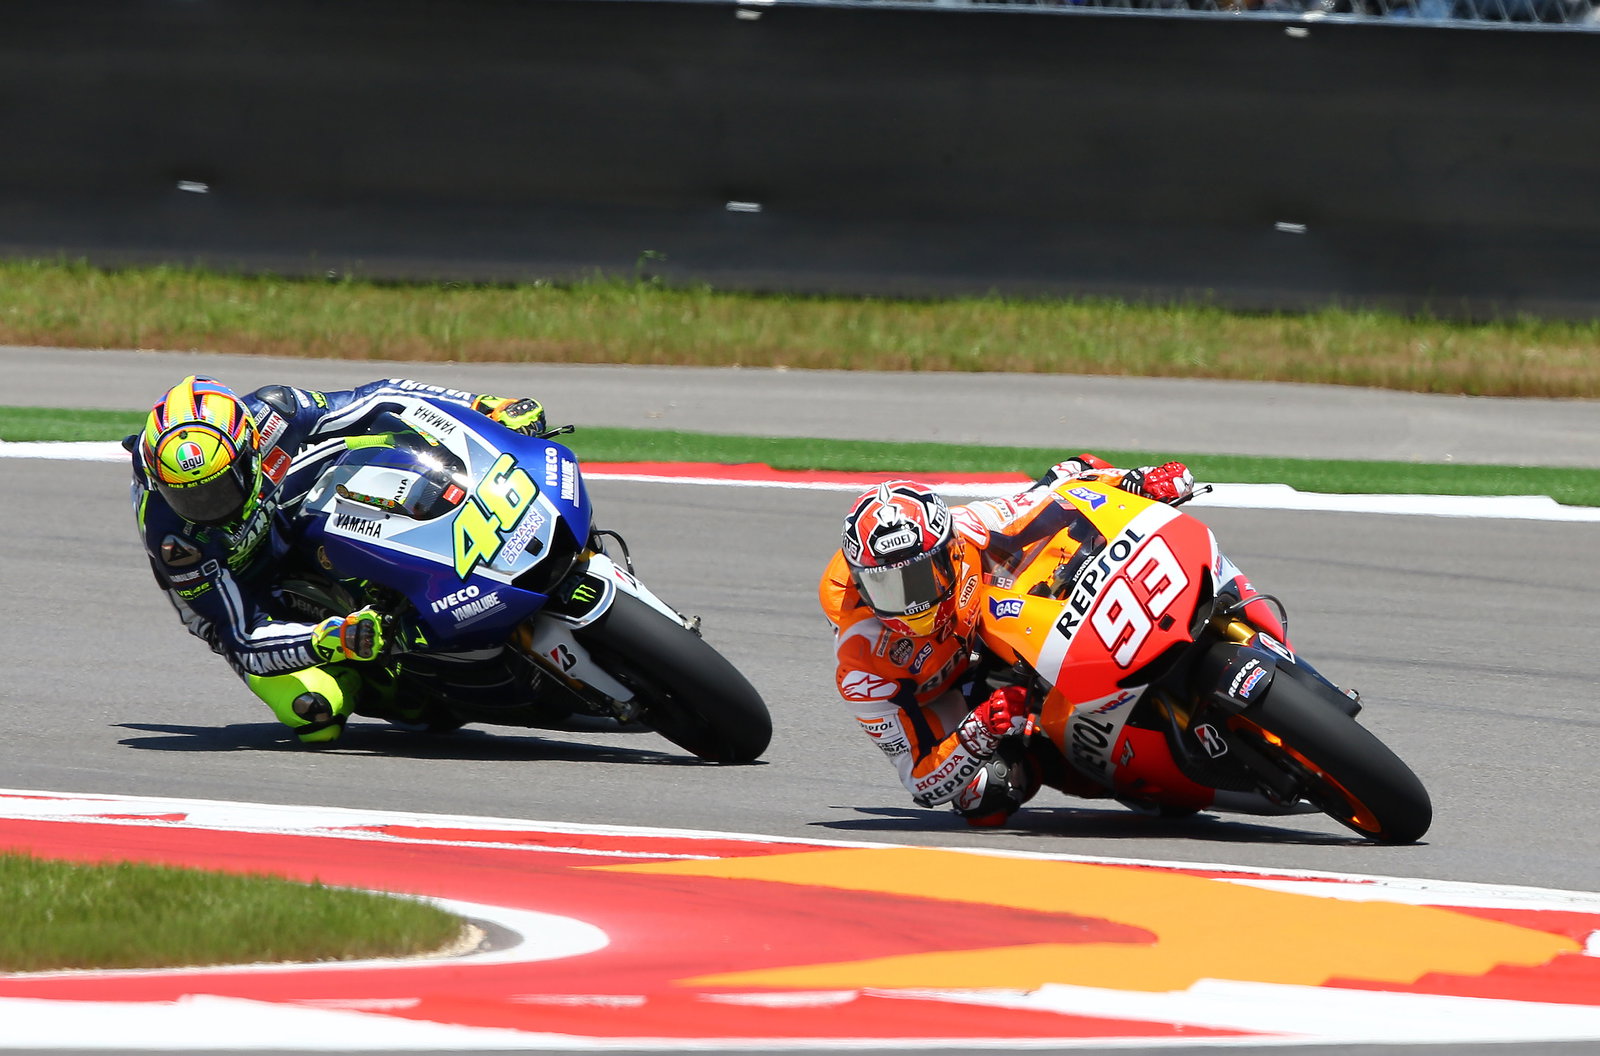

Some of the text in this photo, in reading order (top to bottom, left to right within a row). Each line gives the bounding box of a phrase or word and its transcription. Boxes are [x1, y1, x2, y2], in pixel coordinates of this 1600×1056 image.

[414, 406, 456, 435] YAMAHA
[545, 447, 558, 487] IVECO
[1071, 488, 1102, 500] GAS
[336, 513, 383, 539] YAMAHA
[453, 453, 540, 582] 46
[501, 510, 538, 558] SEMAKIN
[515, 515, 543, 552] DEPAN
[881, 534, 911, 550] SHOEI
[891, 560, 911, 569] YOU
[914, 546, 941, 562] WINGS
[1072, 555, 1095, 582] HONDA
[960, 578, 977, 604] SHOEI
[996, 576, 1014, 590] 93
[1056, 529, 1145, 641] REPSOL
[431, 585, 480, 613] IVECO
[451, 591, 501, 621] YAMALUBE
[904, 602, 931, 616] LOTUS
[996, 602, 1021, 617] GAS
[1090, 534, 1190, 670] 93
[235, 645, 316, 674] YAMAHA
[914, 644, 932, 670] GAS
[1228, 659, 1260, 698] REPSOL
[915, 754, 965, 792] HONDA
[920, 756, 981, 801] REPSOL
